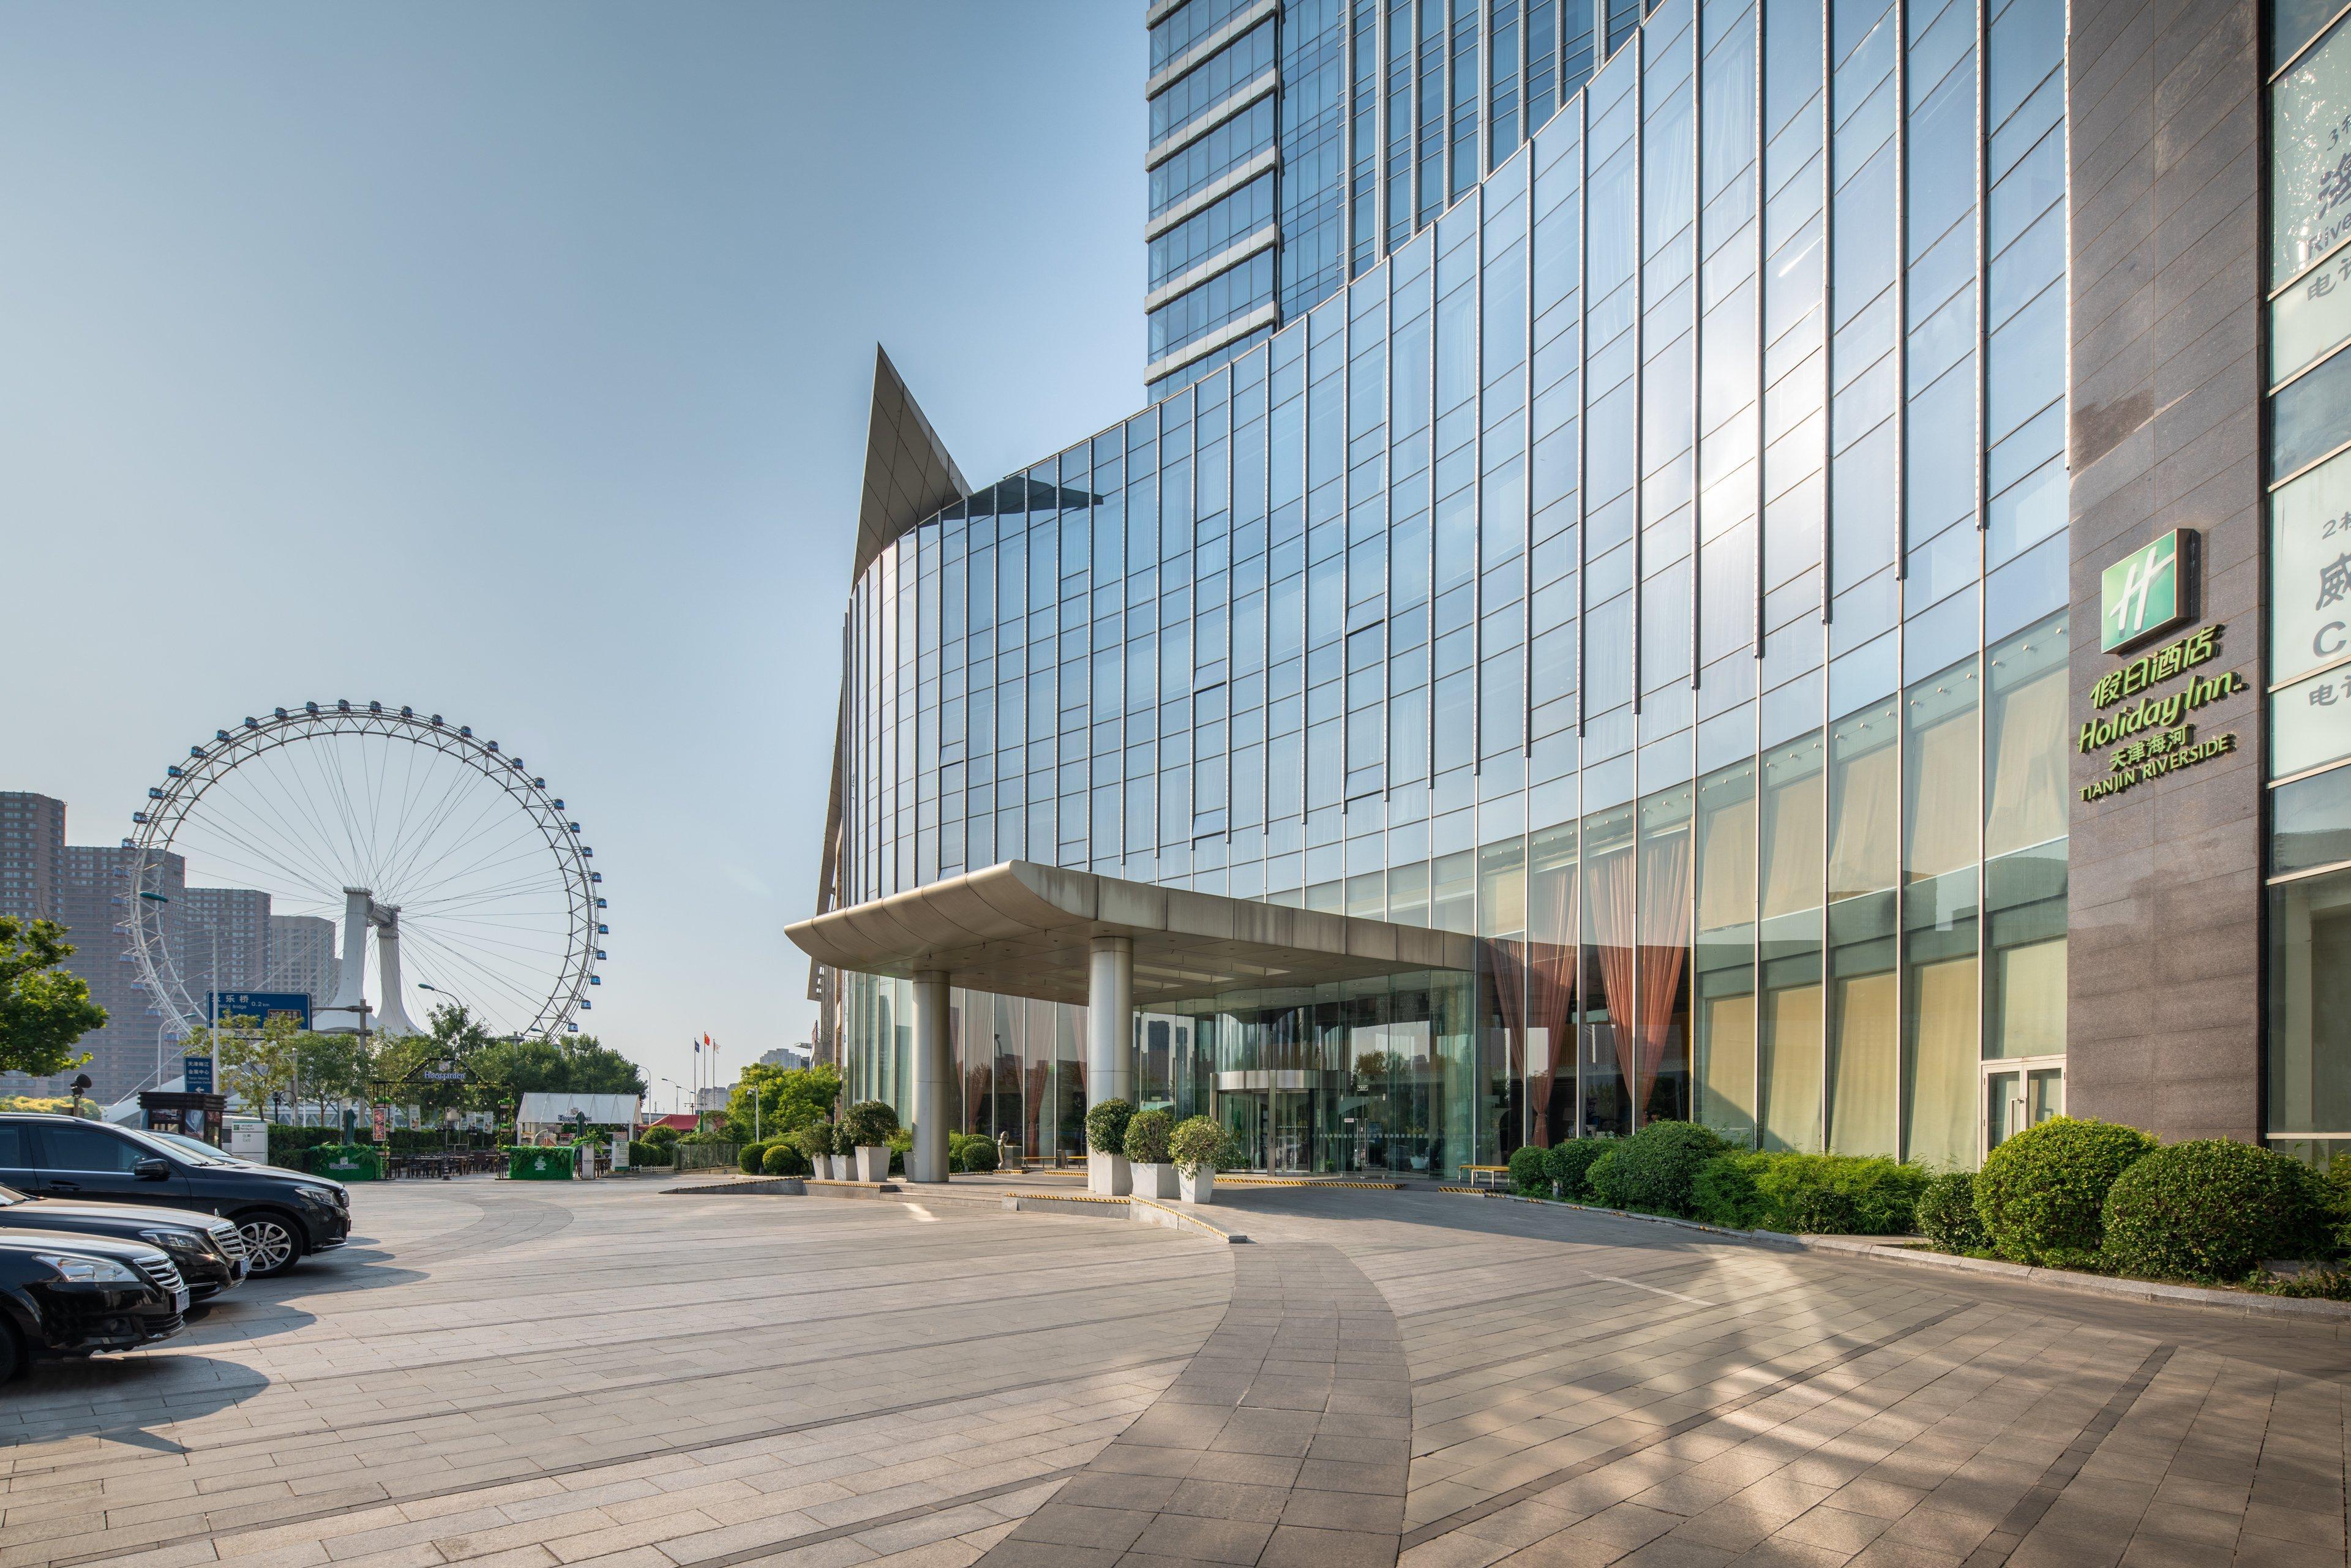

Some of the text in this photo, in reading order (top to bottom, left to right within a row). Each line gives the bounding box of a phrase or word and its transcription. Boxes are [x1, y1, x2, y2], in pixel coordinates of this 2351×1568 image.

[2089, 625, 2222, 709] 假日酒店
[2078, 694, 2186, 753] Holiday
[2109, 724, 2194, 771] 天津海河
[2078, 734, 2235, 801] TIANJIN RIVERSIDE
